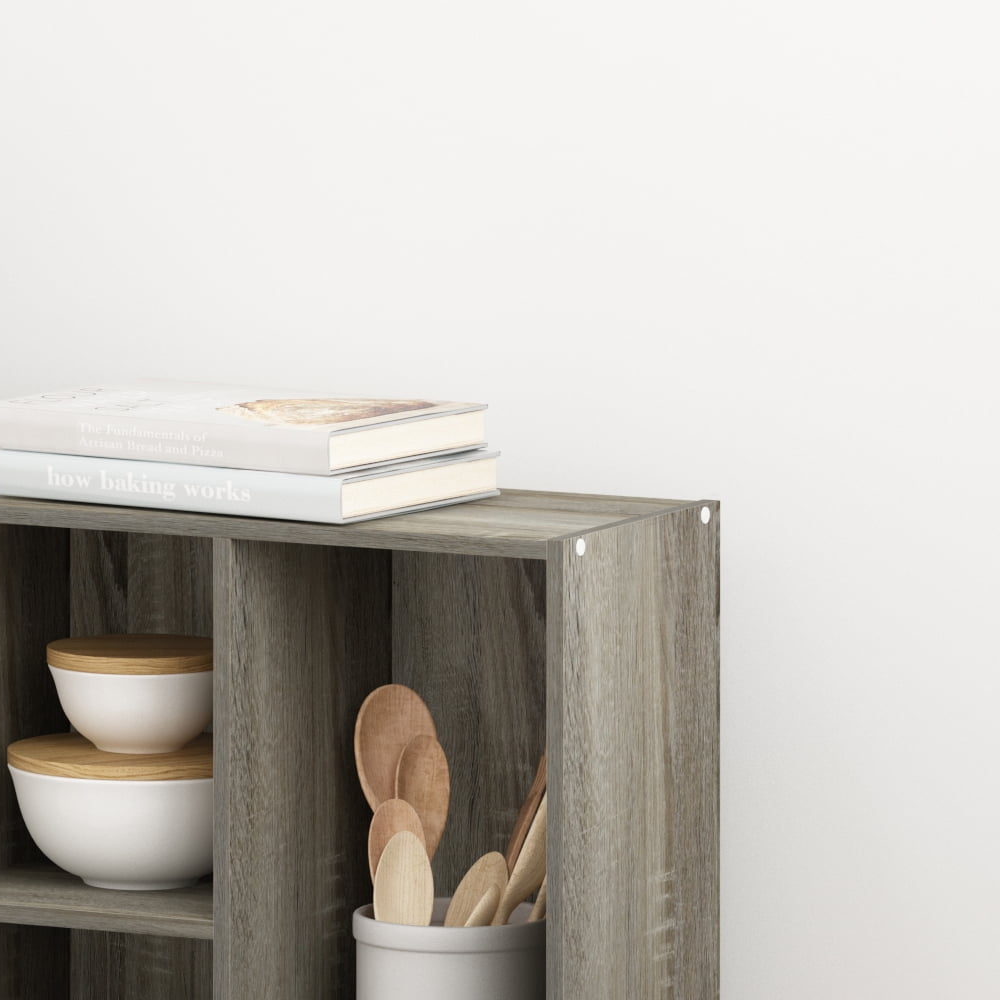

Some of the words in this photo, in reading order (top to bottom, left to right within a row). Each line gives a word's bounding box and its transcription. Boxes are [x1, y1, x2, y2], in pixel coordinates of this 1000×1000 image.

[80, 422, 101, 434] The
[105, 424, 191, 442] Fundamentals
[193, 431, 208, 442] of
[79, 437, 123, 450] Artisan
[128, 440, 162, 453] Bread
[164, 444, 187, 455] and
[191, 446, 224, 458] Pizza
[47, 466, 91, 488] how
[100, 470, 176, 499] baking
[184, 480, 251, 501] works
